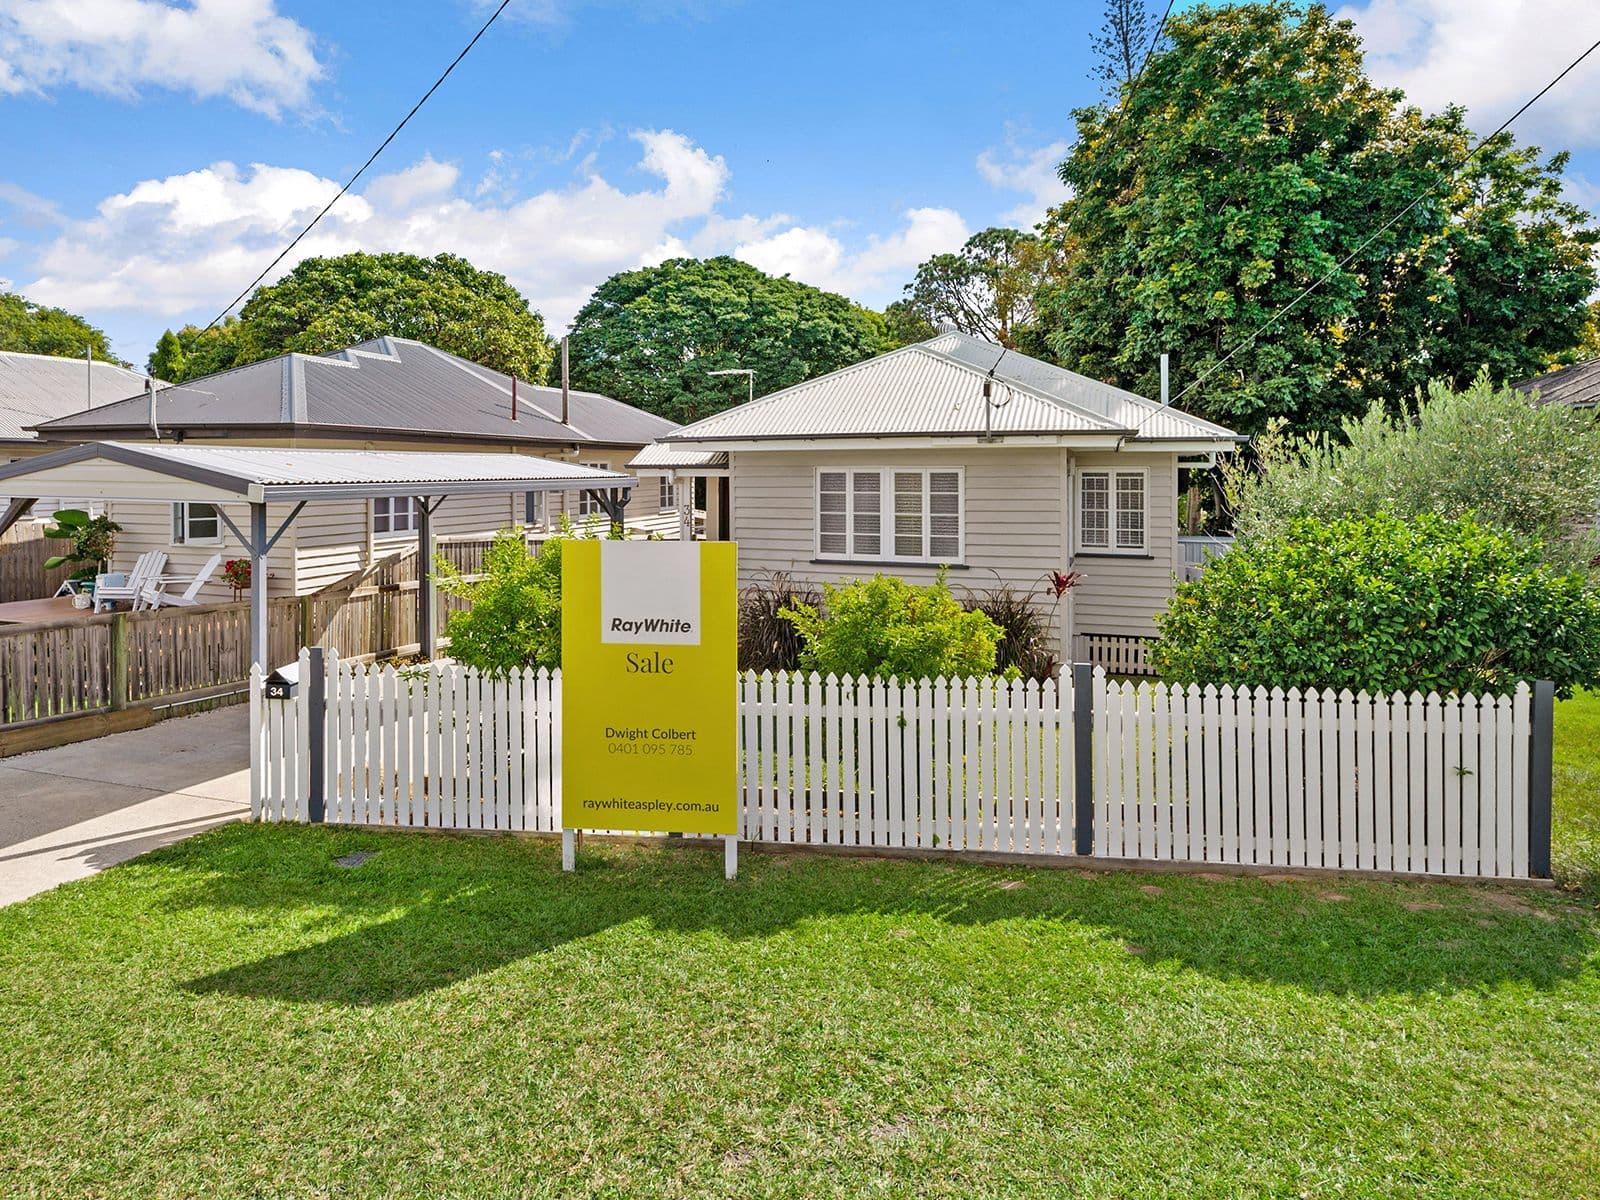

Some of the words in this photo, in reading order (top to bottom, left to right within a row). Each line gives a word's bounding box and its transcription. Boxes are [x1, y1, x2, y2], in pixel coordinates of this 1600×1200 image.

[626, 651, 674, 674] Sale
[270, 687, 283, 696] 34
[605, 727, 648, 741] Dwight
[651, 727, 696, 740] Colbert
[608, 742, 638, 755] 0401
[642, 743, 666, 755] 095
[670, 743, 693, 756] 785
[583, 798, 719, 813] raywhiteaspley.com.au
